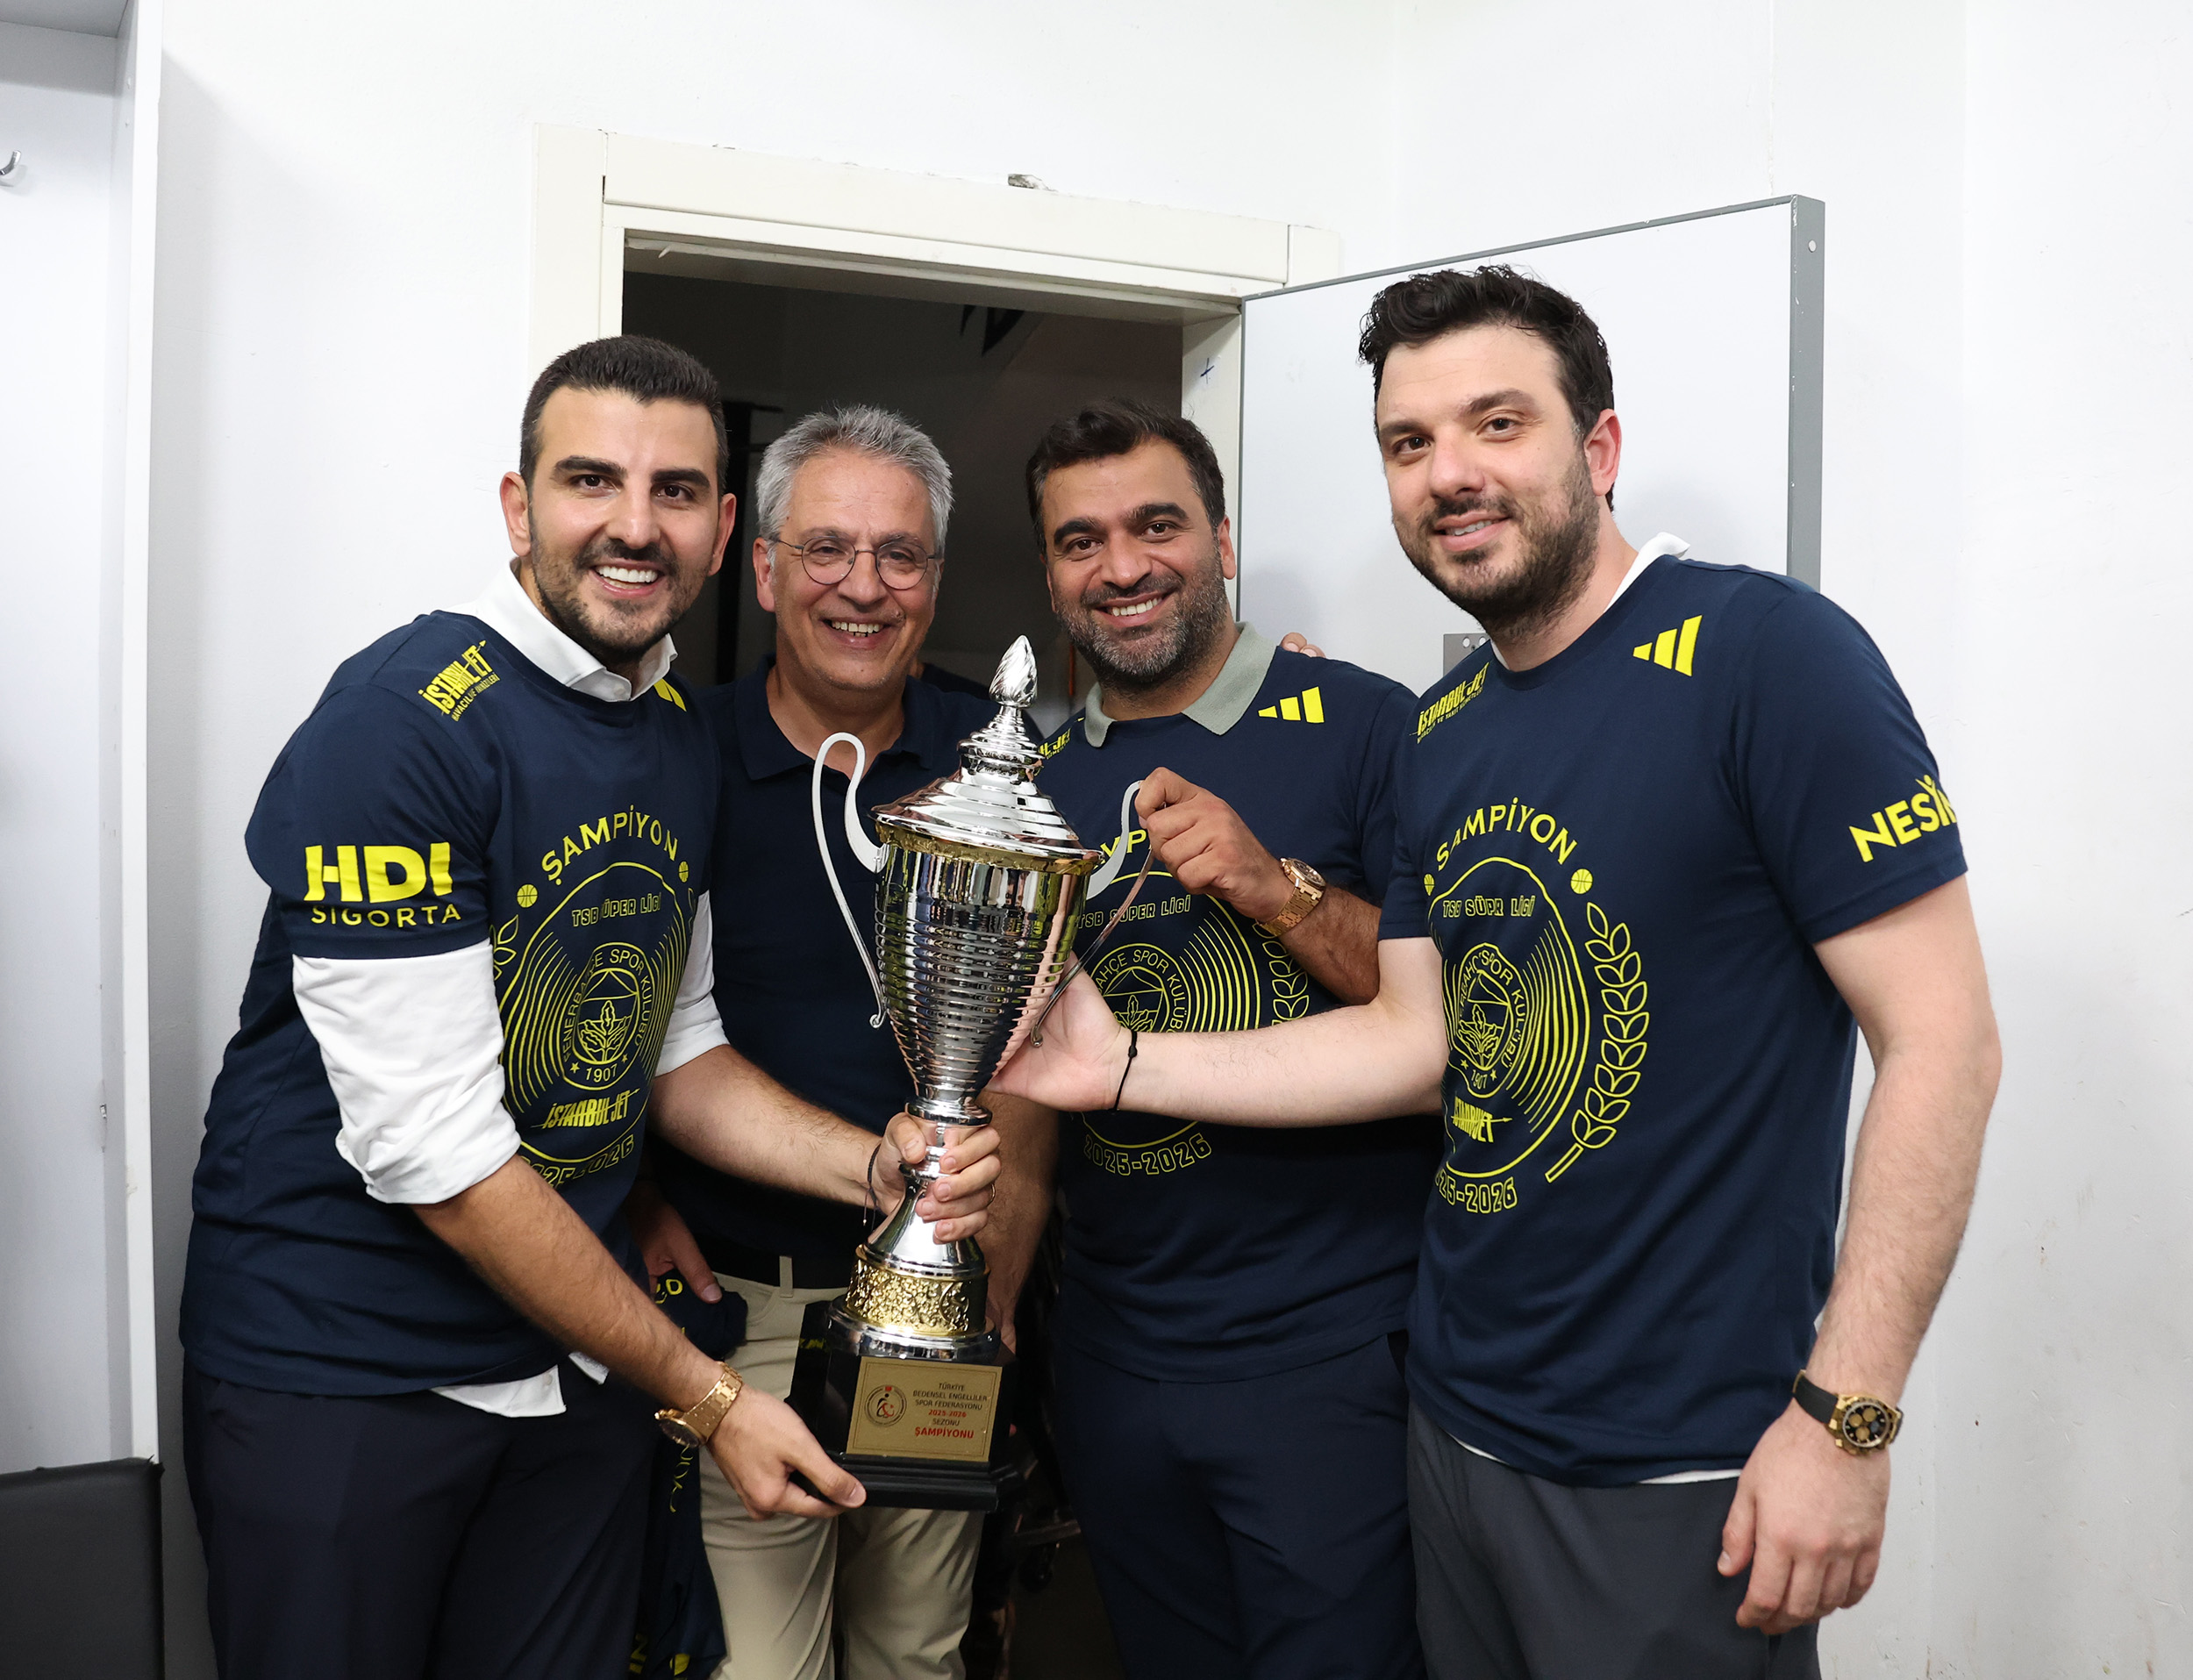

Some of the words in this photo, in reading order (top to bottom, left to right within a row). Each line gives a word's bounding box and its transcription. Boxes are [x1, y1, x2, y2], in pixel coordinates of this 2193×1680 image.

[540, 804, 678, 887] ŞAMPİYON
[303, 841, 454, 904] HDI
[311, 904, 461, 928] SIGORTA
[571, 906, 599, 927] TSB
[1161, 894, 1191, 917] LİGİ
[1511, 895, 1536, 918] LİGİ
[609, 948, 645, 976] SPOR
[1132, 949, 1169, 974] SPOR
[1166, 973, 1187, 1033] KULÜB
[1501, 988, 1527, 1069] KULÜBÜ
[585, 1063, 618, 1083] 1907
[1470, 1069, 1489, 1090] 1907
[541, 1097, 610, 1129] İSTANBUL
[610, 1090, 631, 1122] JET
[1082, 1132, 1212, 1176] 2025-2026
[912, 1390, 946, 1400] BEDENSEL
[948, 1392, 988, 1402] ENGELLİLER
[939, 1382, 965, 1392] TÜRKİYE
[934, 1400, 983, 1411] FEDERASYONU
[914, 1426, 975, 1439] ŞAMPİYONU
[932, 1418, 961, 1426] SEZONU
